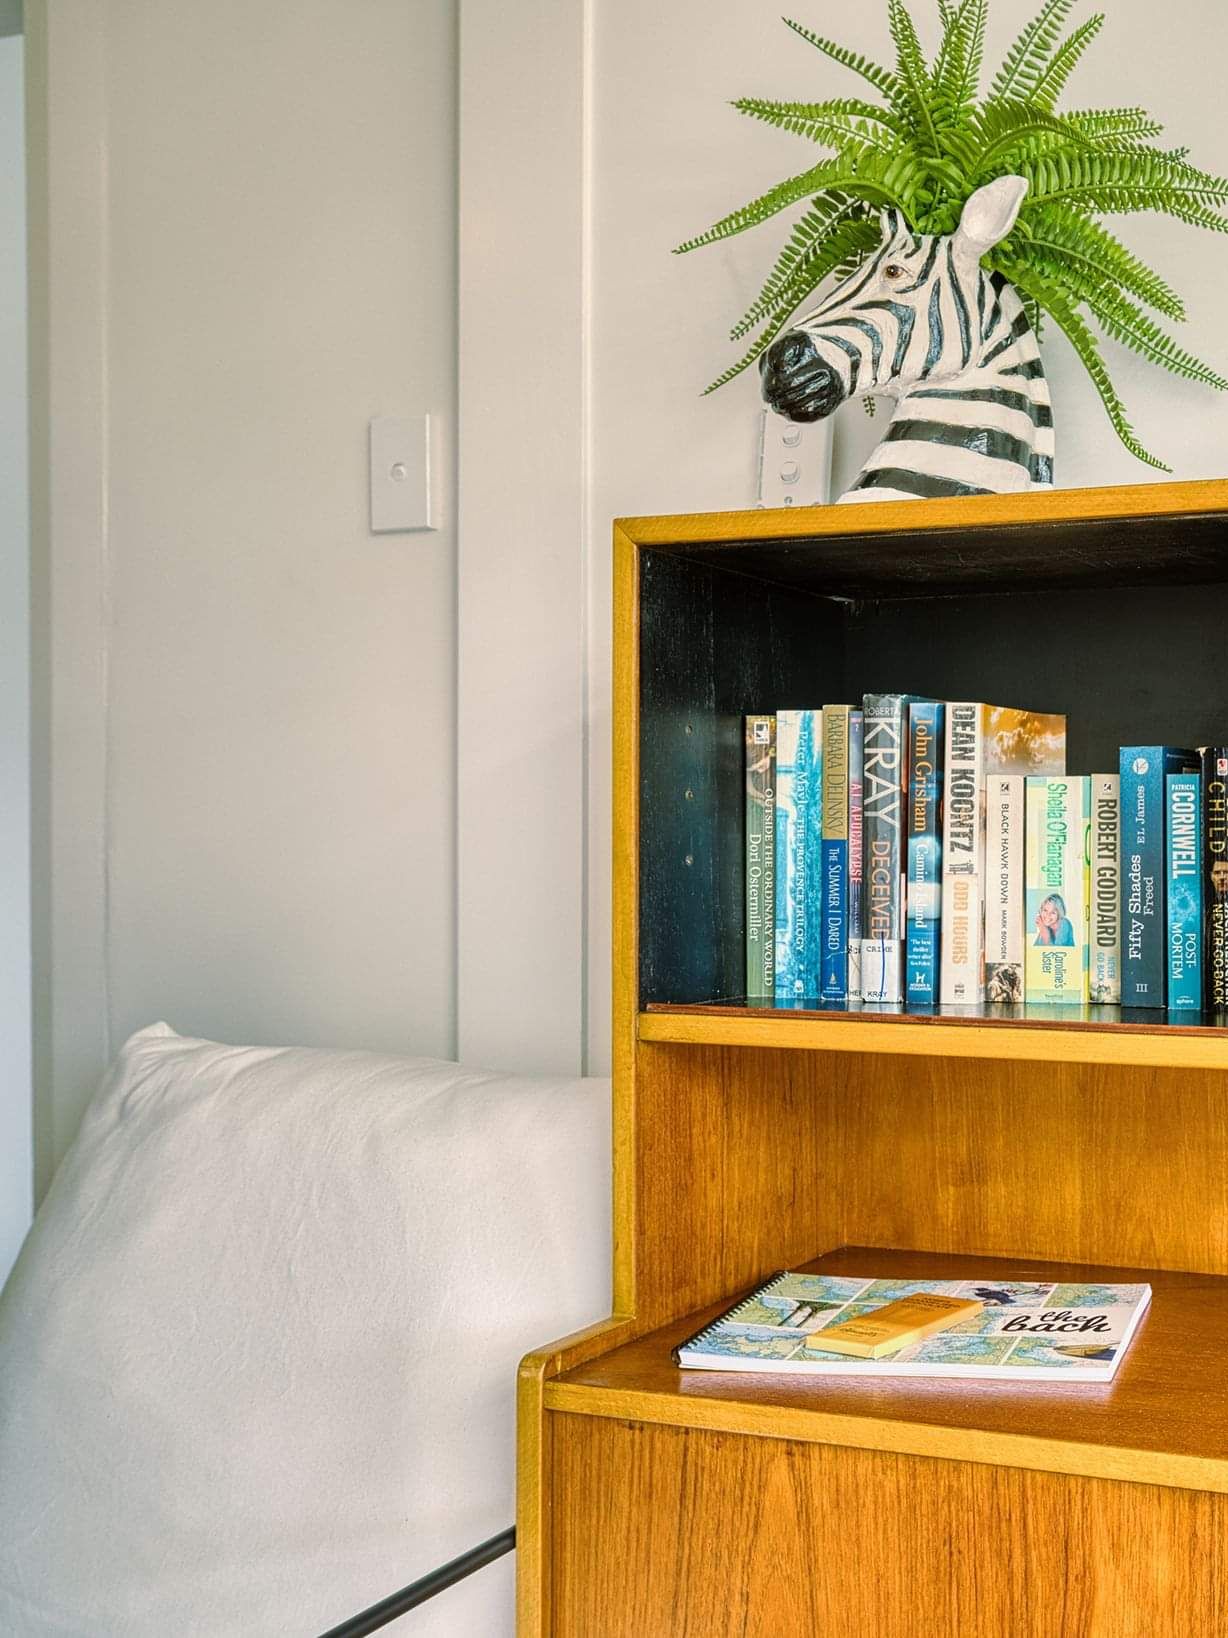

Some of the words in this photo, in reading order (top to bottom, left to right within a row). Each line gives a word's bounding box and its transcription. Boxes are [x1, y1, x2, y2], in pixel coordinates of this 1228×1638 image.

[797, 731, 808, 762] Peter
[827, 714, 846, 769] BARBARA
[914, 717, 933, 757] John
[951, 705, 976, 760] DEAN
[796, 770, 808, 812] Mayle
[864, 718, 901, 826] KRAY
[763, 788, 774, 843] OUTSIDE
[827, 773, 847, 834] DELINSKY
[914, 761, 933, 833] Grisham
[950, 769, 975, 853] KOONTZ
[1047, 783, 1068, 819] Sheila
[1136, 785, 1145, 825] James
[1208, 781, 1226, 853] CHILD
[795, 819, 806, 840] THE
[1000, 803, 1010, 835] BLACK
[1097, 799, 1118, 862] ROBERT
[1171, 791, 1196, 879] CORNWELL
[750, 834, 762, 863] Dori
[763, 845, 774, 868] THE
[829, 847, 840, 862] THE
[851, 805, 862, 884] APOCALYPSE
[1000, 838, 1010, 870] HAWK
[795, 843, 806, 902] PROVENCE
[828, 865, 842, 907] SUMMER
[870, 841, 891, 940] DECEIVED
[1000, 874, 1009, 904] DOWN
[1129, 854, 1142, 914] Shades
[749, 866, 762, 942] Ostermiller
[763, 871, 774, 937] ORDINARY
[953, 881, 969, 911] ODD
[1096, 866, 1118, 948] GODDARD
[1143, 876, 1154, 916] Freed
[795, 904, 806, 953] TRILOGY
[828, 916, 842, 950] DARED
[952, 915, 969, 965] HOURS
[1000, 910, 1008, 929] MARK
[1129, 918, 1144, 960] Fifty
[1212, 903, 1224, 946] NEVER
[763, 940, 774, 986] WORLD
[1000, 931, 1008, 960] BOWDEN
[1042, 952, 1055, 973] Sister
[1171, 922, 1184, 980] MORTEM
[1184, 933, 1197, 968] POST-
[1051, 951, 1067, 989] Caroline's
[1213, 970, 1224, 1005] BACK
[867, 990, 888, 998] KRAY
[1001, 1315, 1111, 1333] bach
